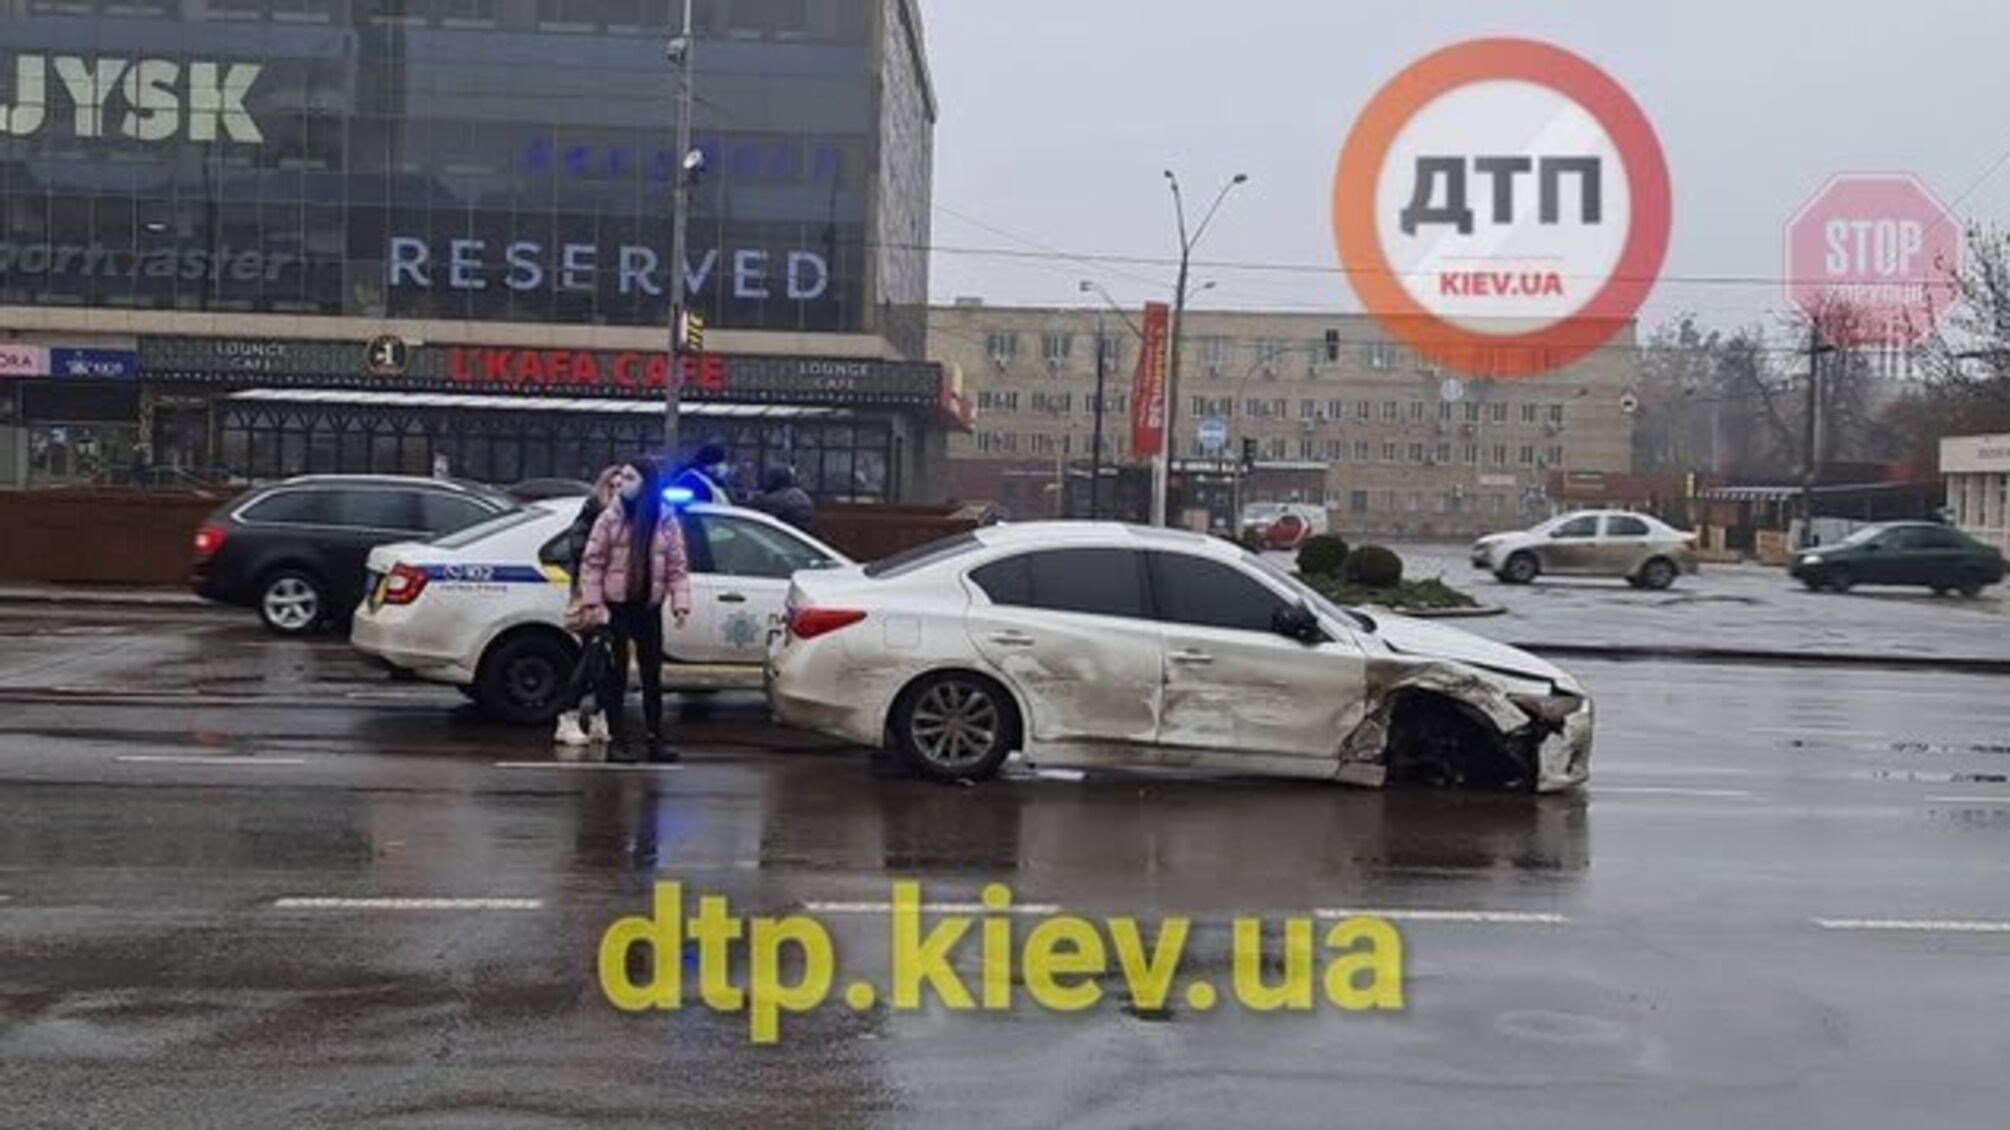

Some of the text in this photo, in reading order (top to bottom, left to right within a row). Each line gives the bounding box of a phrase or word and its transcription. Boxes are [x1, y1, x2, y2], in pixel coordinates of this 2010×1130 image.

[0, 55, 264, 143] JYSK
[388, 237, 828, 300] RESERVED
[451, 348, 725, 387] L'KAFA CAFE
[800, 362, 869, 376] LOUNGE
